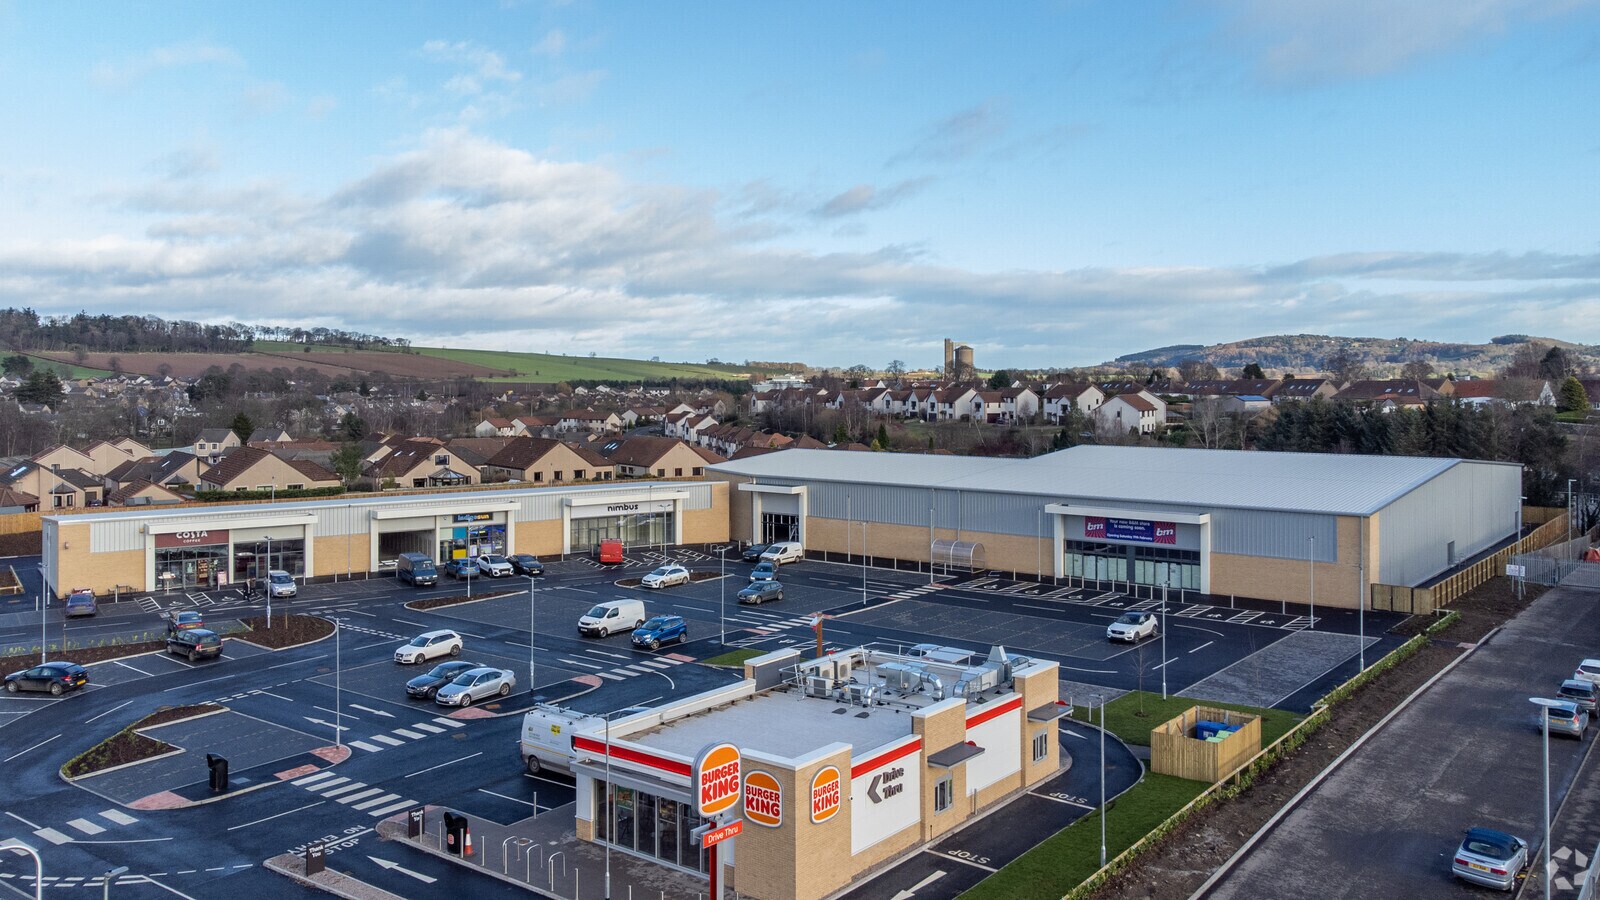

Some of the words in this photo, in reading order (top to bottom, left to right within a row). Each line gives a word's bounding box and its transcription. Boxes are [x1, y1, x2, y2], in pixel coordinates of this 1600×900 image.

[176, 531, 208, 539] COSTA
[701, 761, 739, 786] BURGER
[883, 766, 904, 784] Drive
[701, 775, 739, 804] KING
[745, 785, 780, 803] BURGER
[813, 780, 839, 799] BURGER
[883, 783, 903, 799] Thru
[1049, 792, 1088, 804] STOP
[745, 795, 780, 817] KING
[813, 790, 839, 814] KING
[343, 825, 366, 834] NO
[708, 832, 724, 844] Drive
[725, 825, 739, 837] Thru
[324, 838, 359, 855] STOP
[948, 849, 991, 864] STOP
